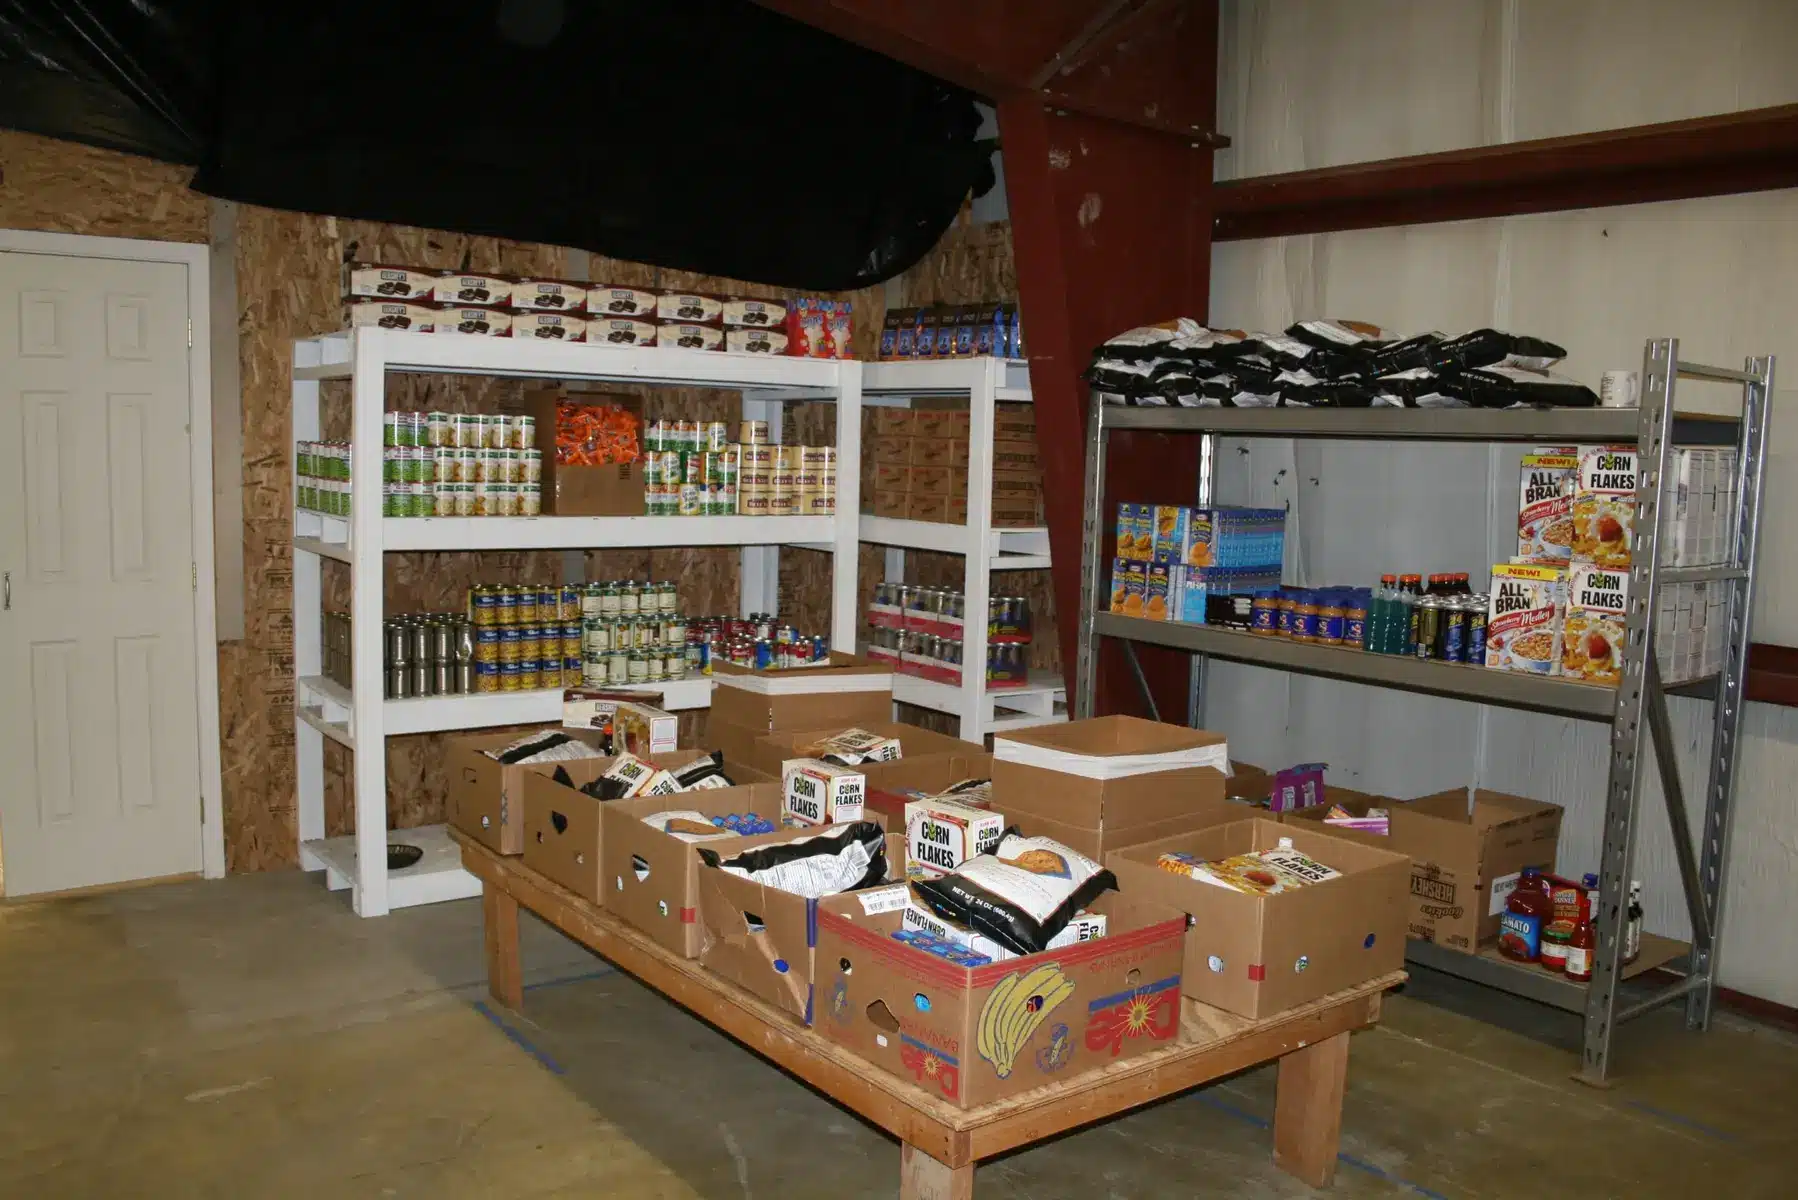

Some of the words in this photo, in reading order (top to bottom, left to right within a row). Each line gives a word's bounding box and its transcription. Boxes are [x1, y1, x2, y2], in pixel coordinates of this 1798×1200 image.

[1596, 453, 1631, 471] CORN
[1590, 473, 1635, 490] FLAKES
[1525, 485, 1560, 504] BRAN
[1508, 567, 1541, 577] NEW!
[1587, 572, 1620, 590] CORN
[1495, 596, 1531, 614] BRAN
[1581, 590, 1624, 609] FLAKES
[1520, 611, 1550, 627] Medley
[618, 762, 645, 781] CORN
[794, 775, 816, 798] CORN
[839, 783, 860, 795] CORN
[790, 794, 818, 819] FLAKES
[835, 794, 863, 806] FLAKES
[921, 821, 950, 846] CORN
[978, 826, 999, 841] CORN
[917, 841, 954, 869] FLAKES
[1271, 858, 1325, 880] FLAKES
[1291, 856, 1332, 874] CORN
[951, 886, 966, 896] NET
[965, 893, 975, 901] WT
[983, 902, 994, 911] OZ
[905, 908, 928, 930] FLAKES
[928, 920, 946, 937] CORN
[1079, 922, 1089, 940] FLA
[1085, 987, 1181, 1057] Dole
[900, 1041, 959, 1101] Dole
